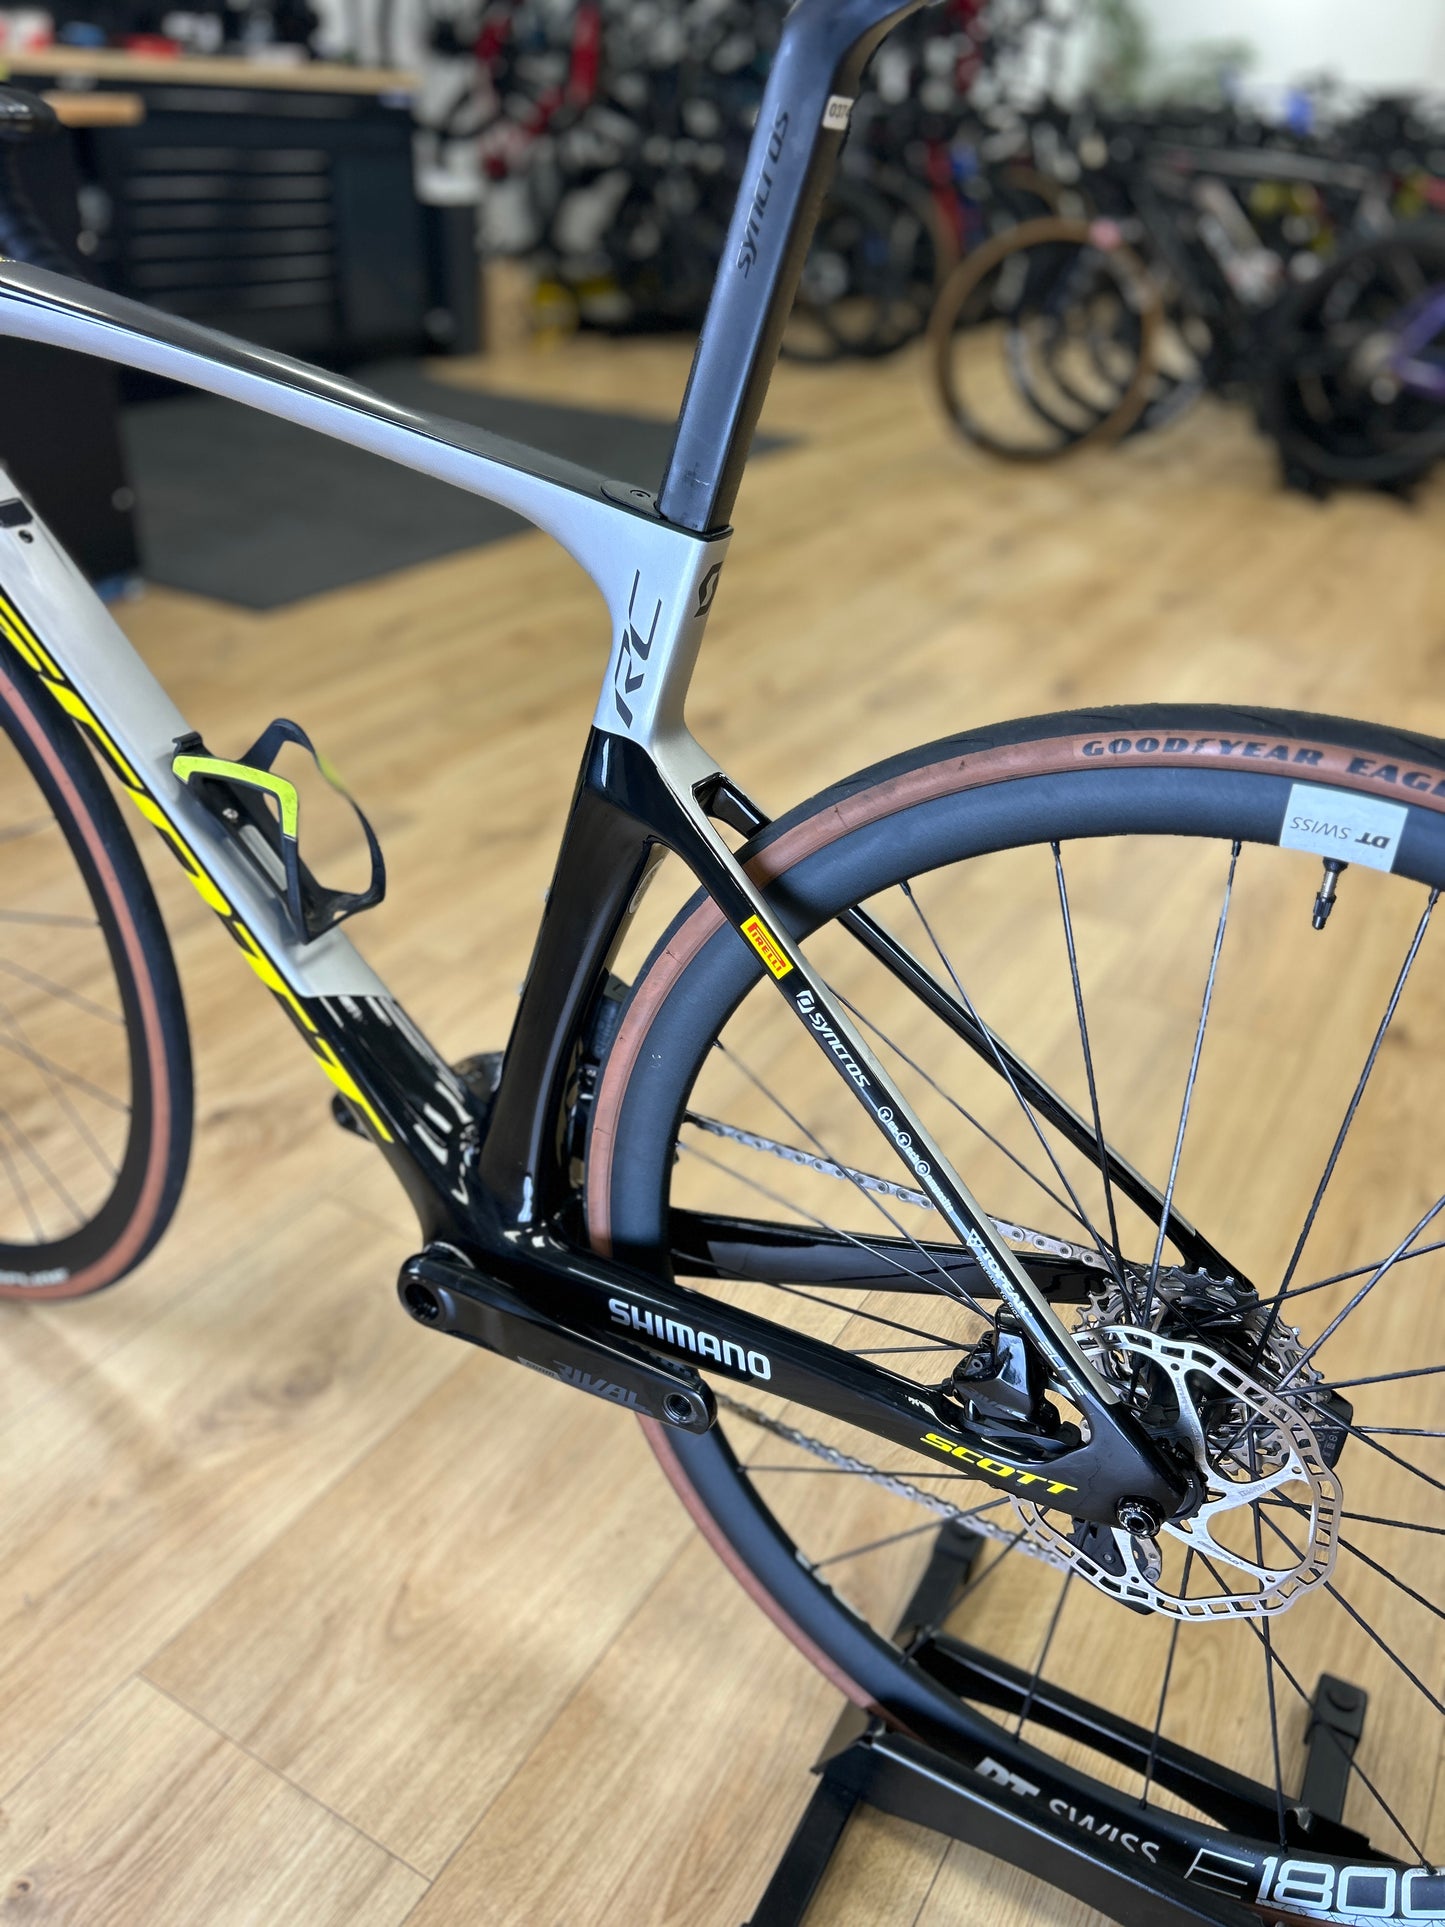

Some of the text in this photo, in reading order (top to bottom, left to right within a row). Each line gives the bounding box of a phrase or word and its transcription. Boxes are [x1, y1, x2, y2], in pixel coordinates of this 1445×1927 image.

[614, 568, 662, 730] RC
[1290, 816, 1391, 849] DT SWISS
[747, 921, 787, 972] PIRELLI
[975, 1255, 1000, 1290] PREPARE
[1007, 1302, 1021, 1320] RIDE
[982, 1246, 1032, 1318] TOPEAK
[608, 1298, 771, 1381] SHIMANO
[919, 1432, 1079, 1495] SCOTT
